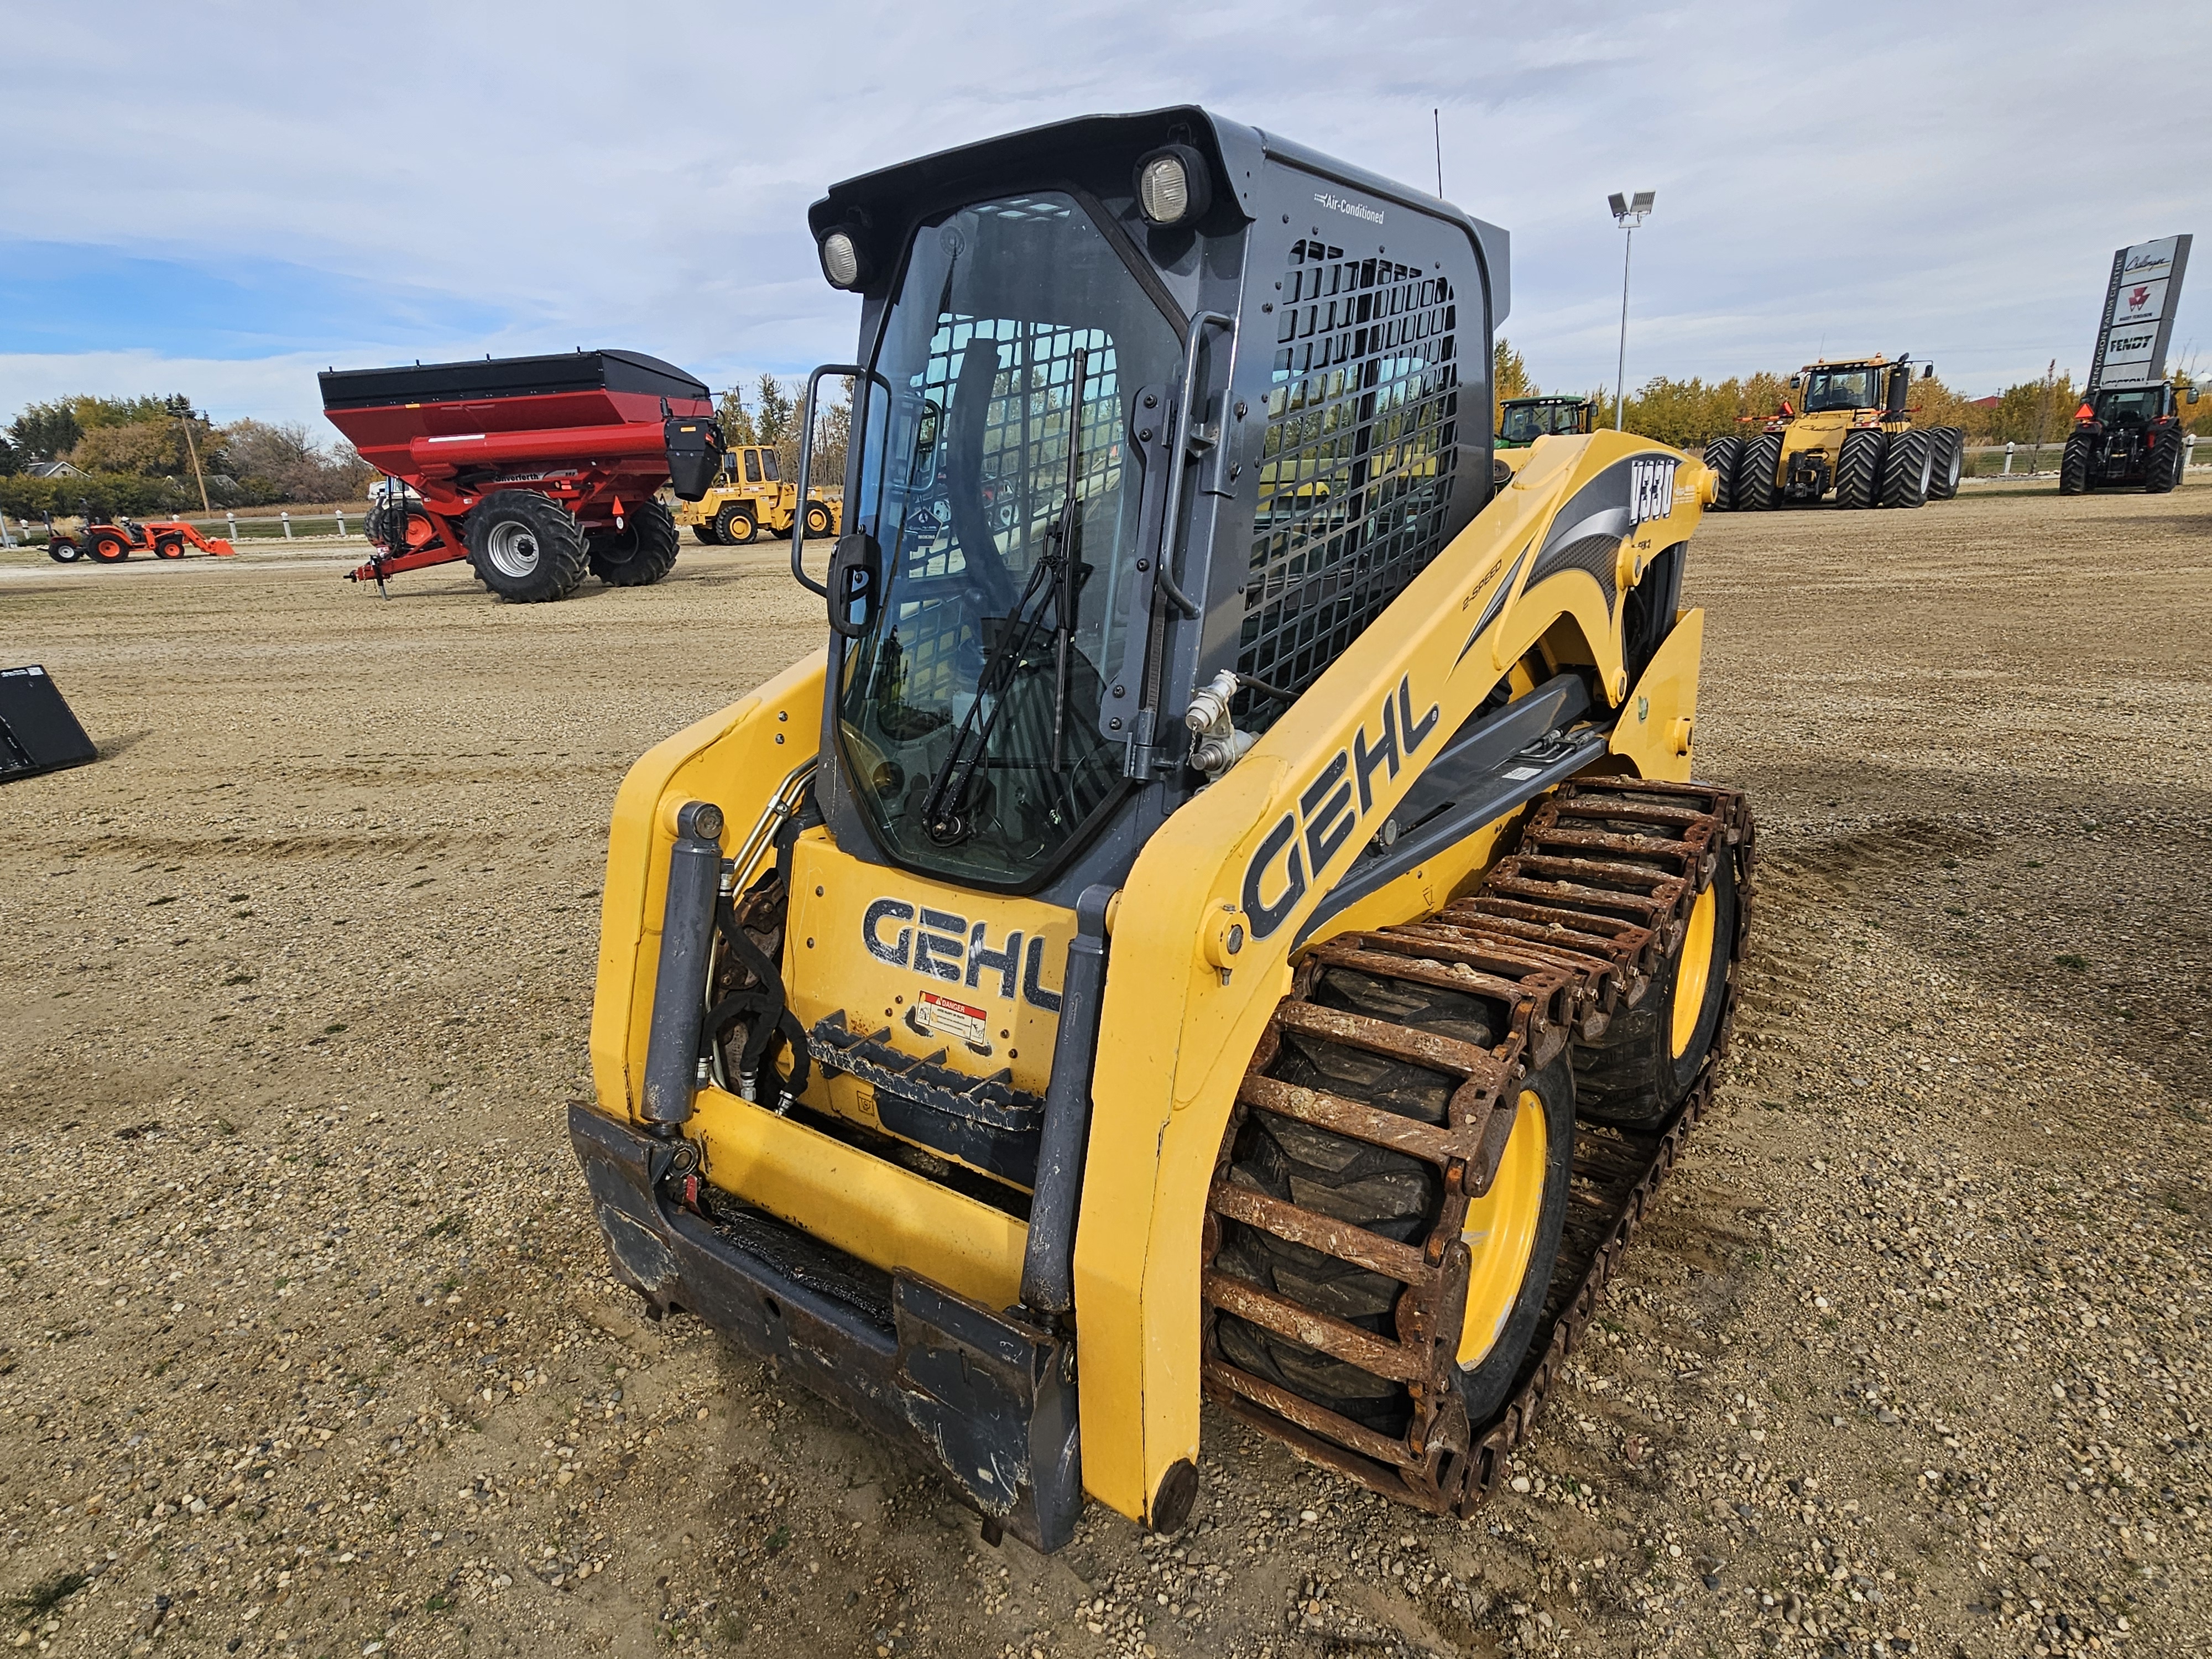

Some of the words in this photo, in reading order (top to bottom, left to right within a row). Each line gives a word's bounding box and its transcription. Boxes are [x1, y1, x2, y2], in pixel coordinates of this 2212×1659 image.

[1326, 194, 1384, 225] Air-Conditioned
[2091, 331, 2108, 386] PENTAGON
[2103, 298, 2114, 329] FARM
[2110, 256, 2124, 296] CENTRE
[2110, 335, 2153, 352] FENDT
[1629, 458, 1675, 526] V330
[1462, 558, 1502, 612] 2-SPEED
[1241, 670, 1439, 941] GEHL
[862, 896, 1063, 1013] GEHL
[942, 999, 966, 1013] DANGER
